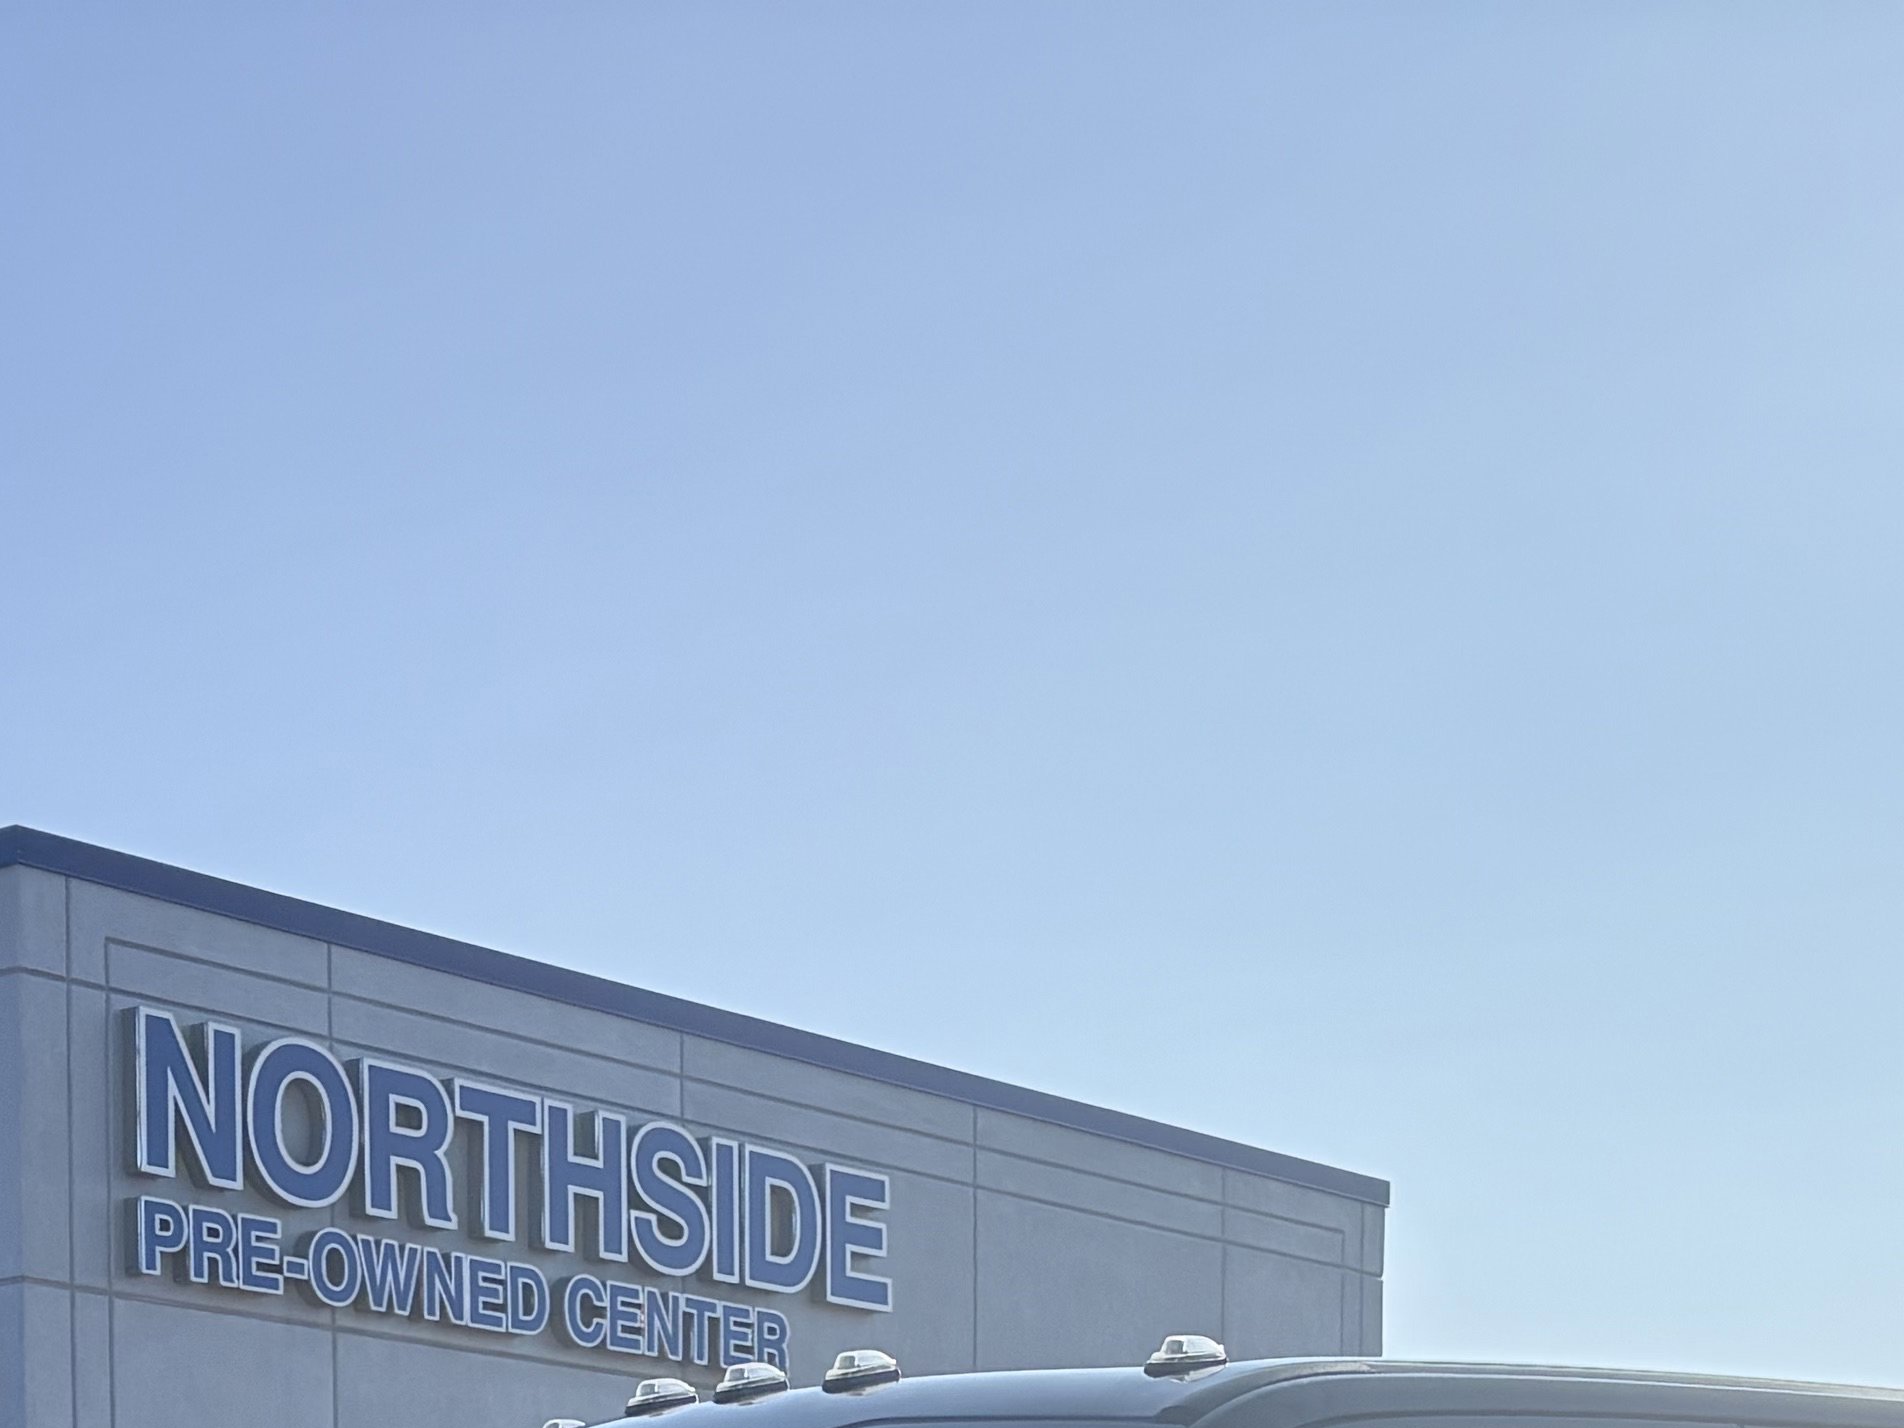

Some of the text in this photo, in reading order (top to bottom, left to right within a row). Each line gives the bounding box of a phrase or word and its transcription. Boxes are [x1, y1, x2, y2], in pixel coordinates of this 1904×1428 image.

[132, 1005, 893, 1312] NORTHSIDE
[134, 1196, 789, 1375] PRE-OWNED CENTER
